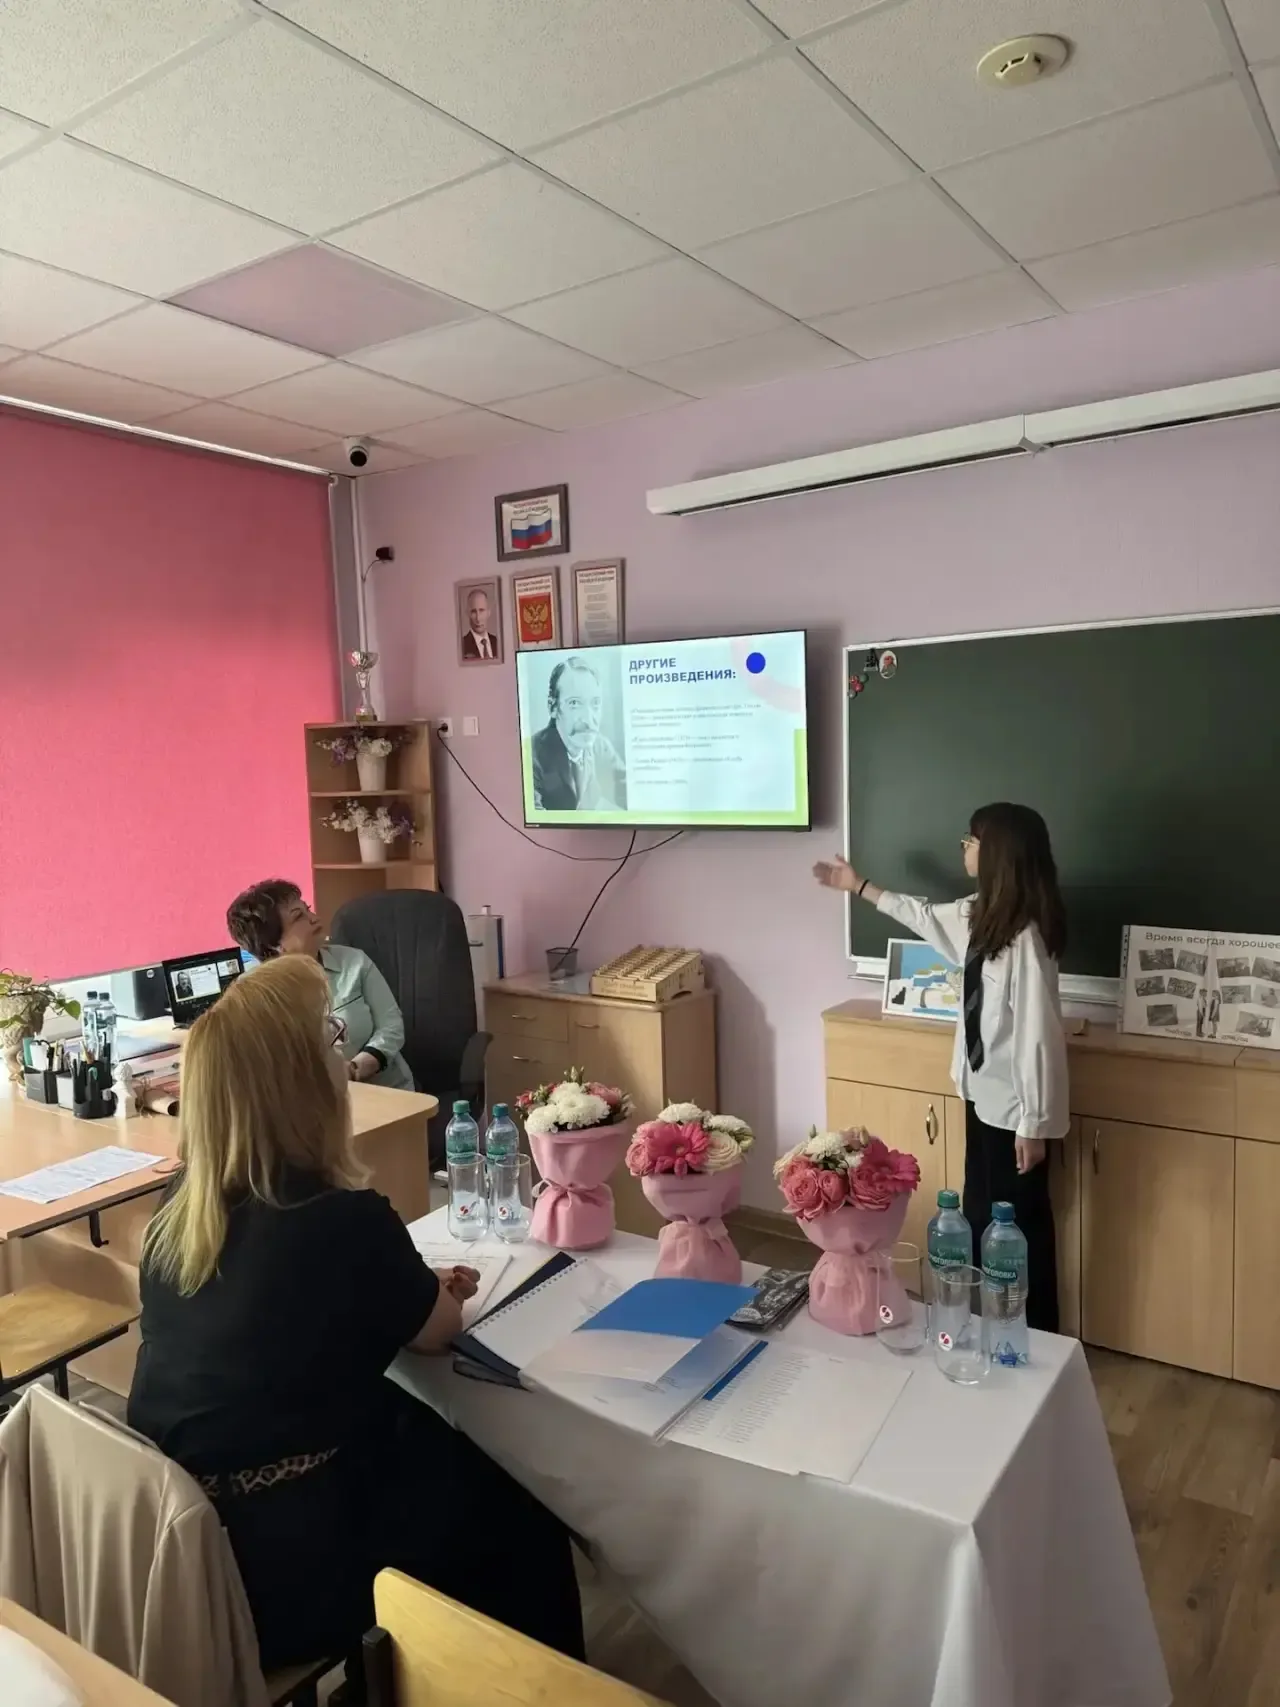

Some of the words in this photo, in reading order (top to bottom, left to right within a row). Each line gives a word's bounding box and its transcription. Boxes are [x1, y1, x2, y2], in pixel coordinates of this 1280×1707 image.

[629, 657, 677, 672] ДРУГИЕ
[629, 668, 737, 685] ПРОИЗВЕДЕНИЯ:
[1145, 932, 1183, 942] Время
[1186, 936, 1225, 946] всегда
